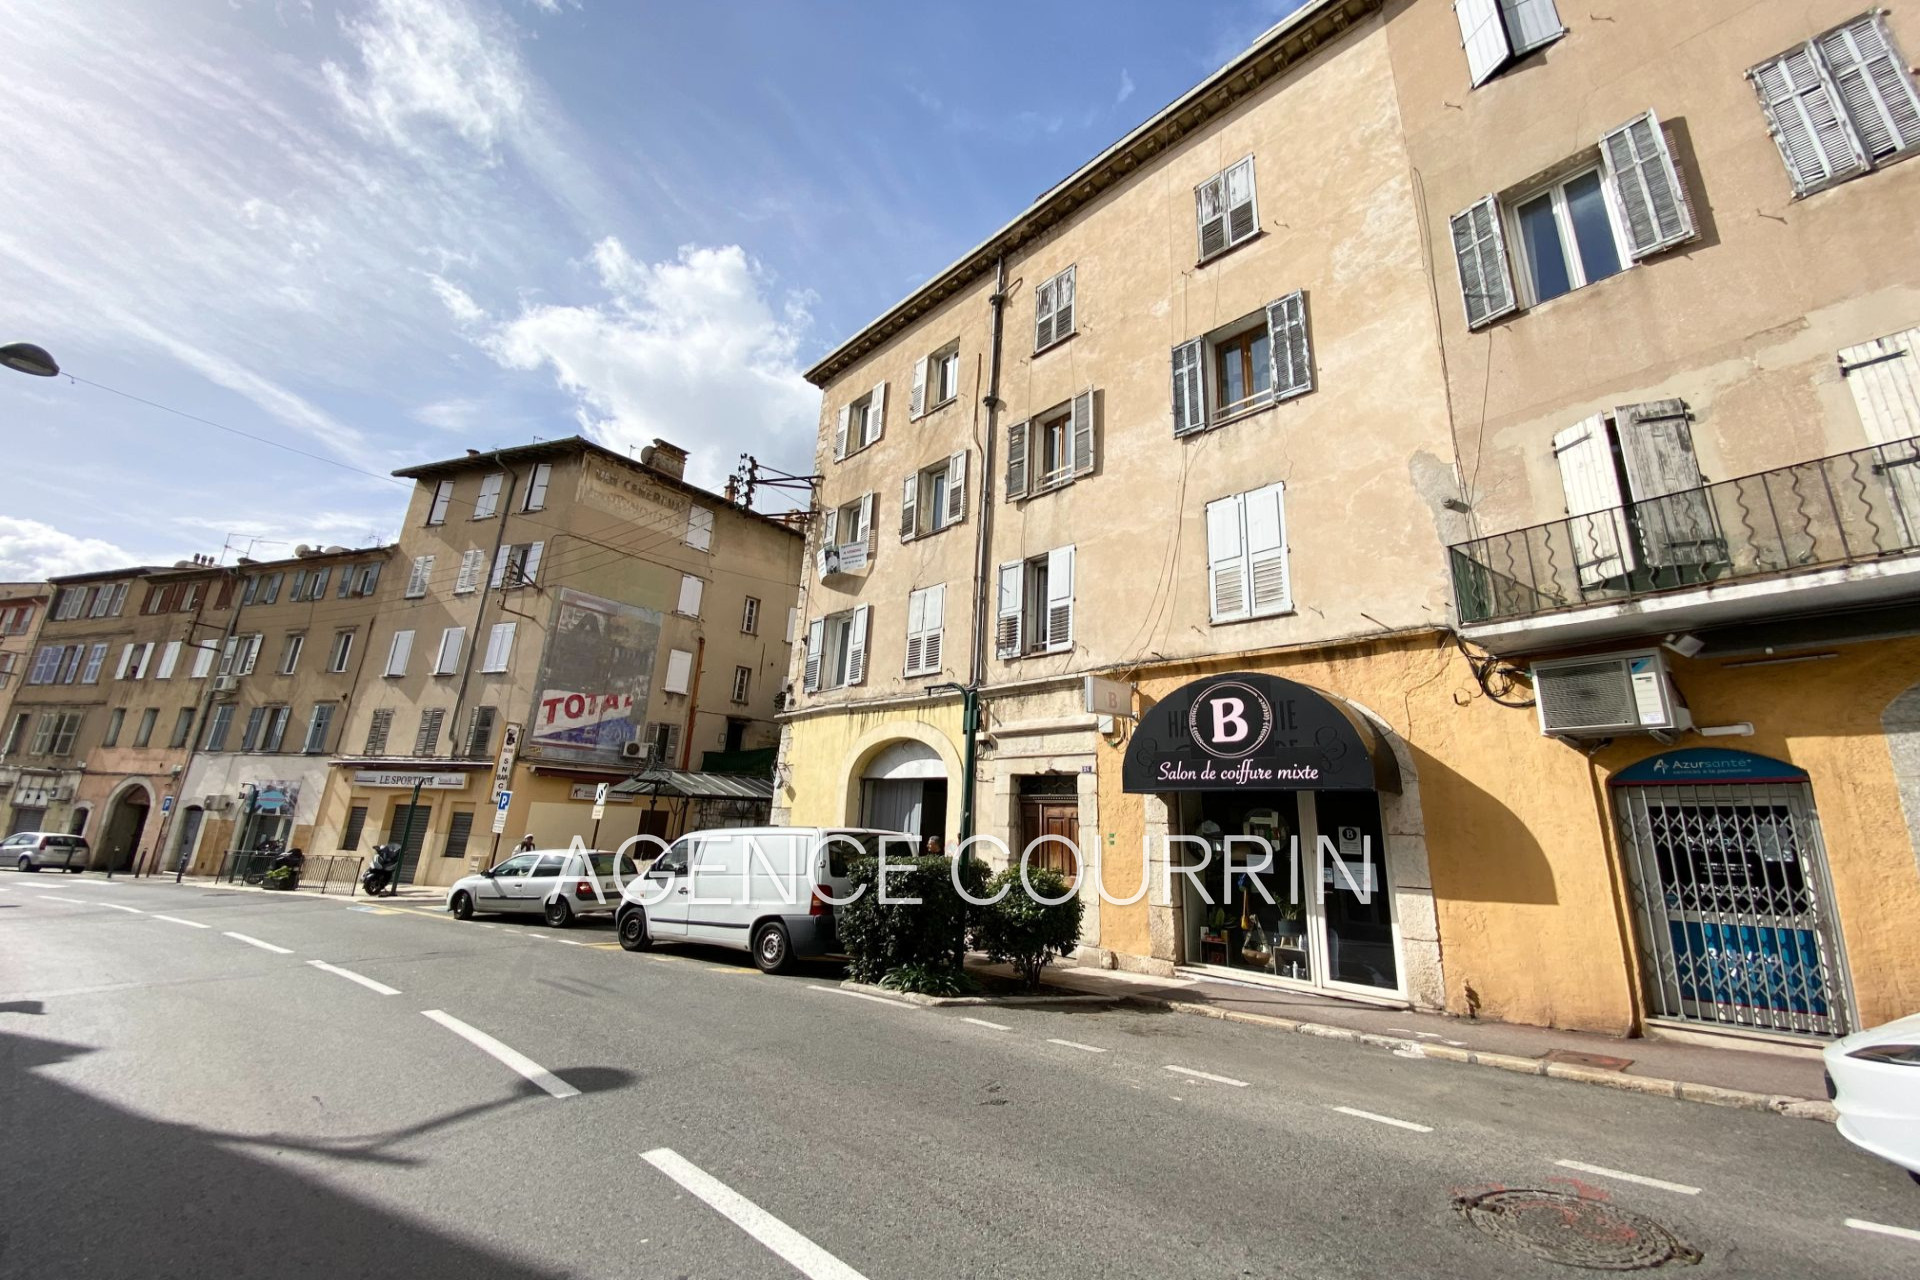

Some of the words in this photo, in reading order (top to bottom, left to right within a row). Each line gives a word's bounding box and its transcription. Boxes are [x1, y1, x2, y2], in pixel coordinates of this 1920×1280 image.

[1108, 692, 1117, 708] B
[1210, 697, 1249, 743] B
[379, 775, 391, 785] LE
[1158, 761, 1197, 780] Salon
[1200, 760, 1217, 780] de
[1220, 759, 1272, 785] coiffure
[1277, 763, 1319, 780] mixte
[500, 795, 508, 807] P
